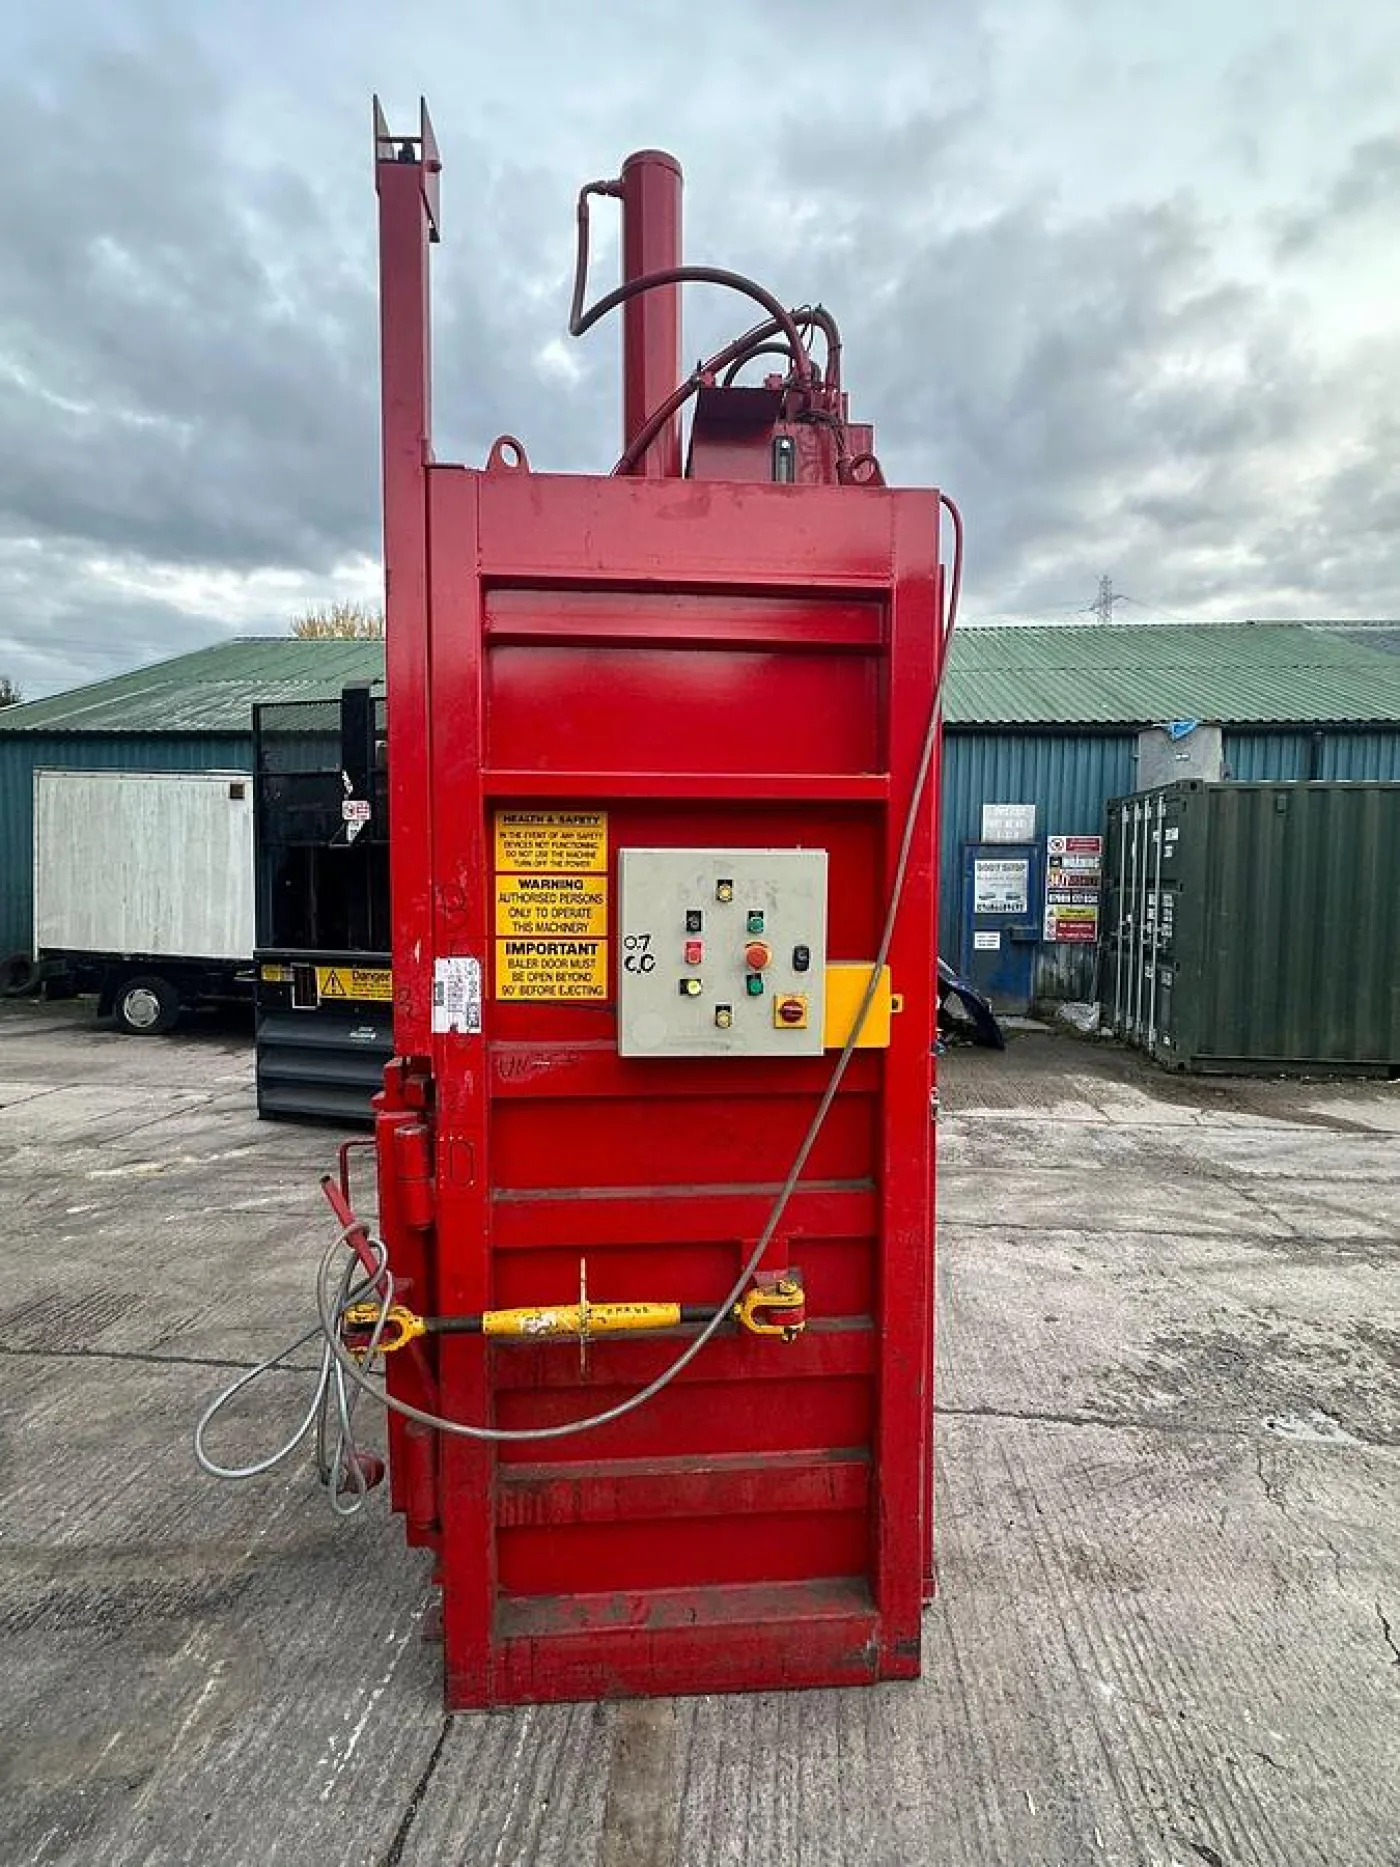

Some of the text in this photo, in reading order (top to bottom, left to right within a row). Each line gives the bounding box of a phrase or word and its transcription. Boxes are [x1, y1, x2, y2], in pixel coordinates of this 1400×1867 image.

[503, 815, 544, 823] HEALTH
[559, 815, 600, 825] SAFETY
[576, 832, 603, 840] SAFETY
[503, 841, 599, 849] DEVICES NOT FUNCTIONING
[551, 850, 564, 858] THE
[565, 850, 596, 859] MACHINE
[518, 879, 584, 890] WARNING
[497, 892, 604, 905] AUTHORISED PERSONS
[508, 907, 592, 919] ONLY TO OPERATE
[512, 921, 589, 933] THIS MACHINERY
[505, 942, 599, 955] IMPORTANT
[507, 958, 596, 969] BALER DOOR MUST
[352, 971, 391, 984] Danger
[511, 971, 593, 982] BE OPEN BEYOND
[519, 985, 557, 996] BEFORE
[559, 985, 604, 996] EJECTING
